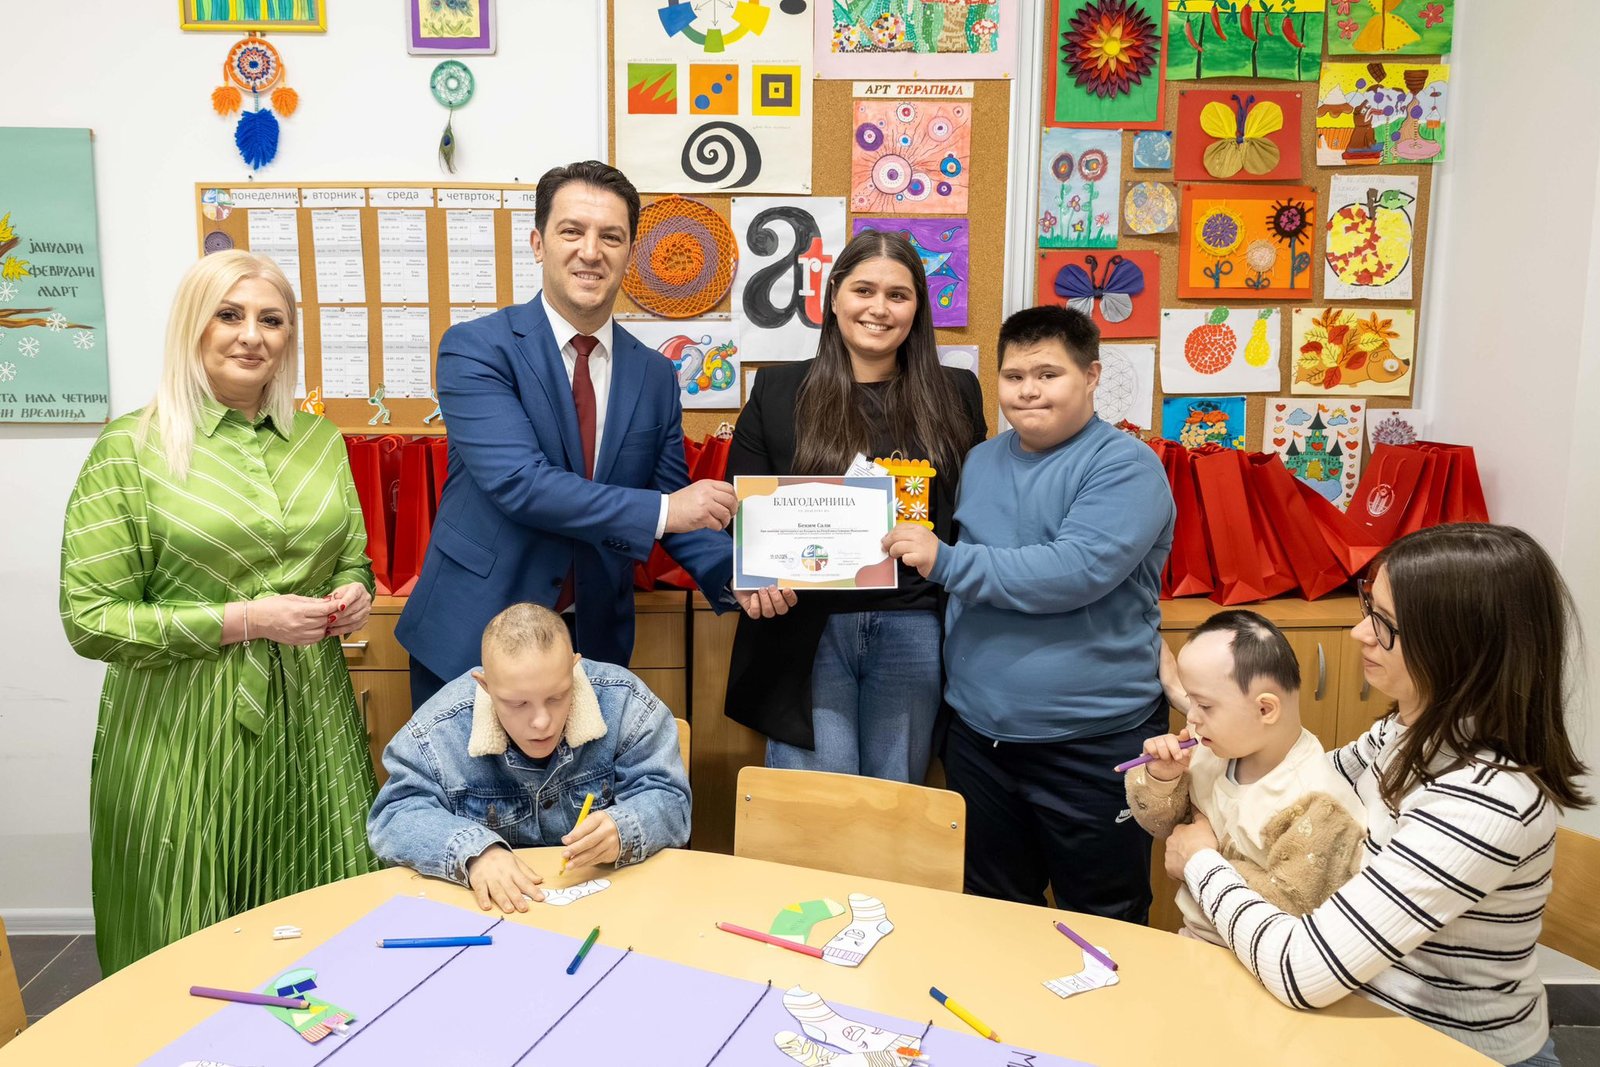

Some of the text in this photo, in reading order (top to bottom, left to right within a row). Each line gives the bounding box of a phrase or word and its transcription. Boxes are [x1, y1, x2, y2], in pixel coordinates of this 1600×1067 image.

[864, 84, 964, 96] АРТ ТЕРАПИЈА
[231, 190, 299, 202] понеделник
[312, 191, 358, 201] вторник
[387, 191, 419, 200] среда
[446, 191, 495, 202] четврток
[28, 264, 96, 278] ФЕВРУАРИ
[37, 286, 78, 298] МАРТ
[25, 393, 56, 403] ИМА
[62, 393, 108, 403] ЧЕТИРИ
[21, 408, 86, 420] ВРЕМИЊА
[773, 497, 856, 507] БЛАГОДАРНИЦА
